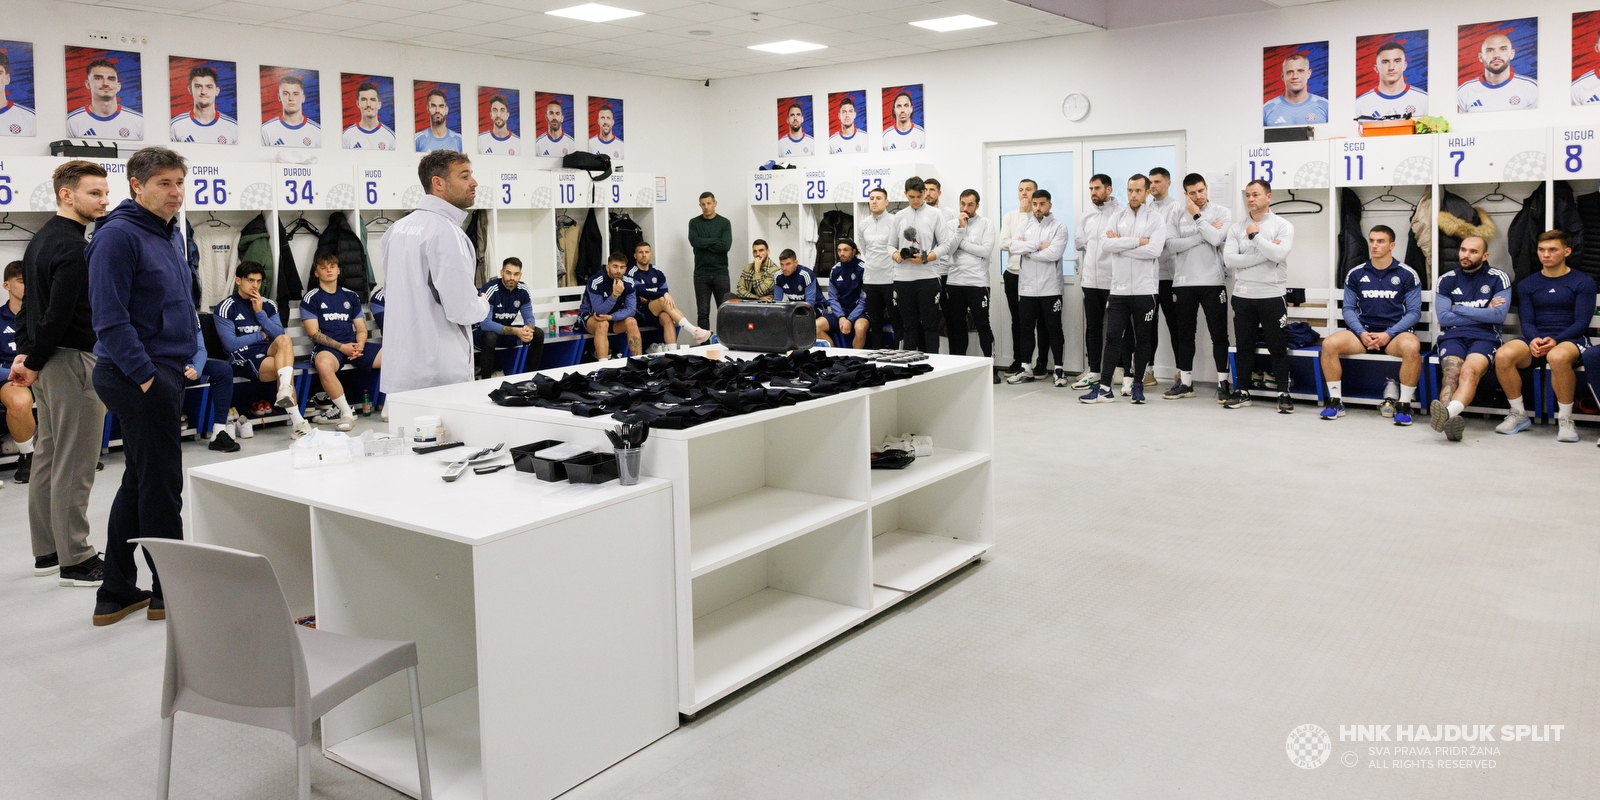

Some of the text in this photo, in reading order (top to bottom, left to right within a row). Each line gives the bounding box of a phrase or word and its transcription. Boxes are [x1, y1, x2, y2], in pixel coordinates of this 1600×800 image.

[1448, 137, 1476, 148] KALIK
[1563, 129, 1595, 142] SIGUR
[1248, 147, 1271, 158] LUČIĆ
[1343, 142, 1366, 152] ŠEGO
[1449, 150, 1465, 178] 7
[1564, 144, 1583, 173] 8
[192, 166, 219, 176] CAPAN
[283, 167, 312, 177] DURDOV
[364, 169, 382, 179] HUGO
[501, 173, 518, 181] EDGAR
[1249, 160, 1274, 184] 13
[1344, 155, 1364, 181] 11
[194, 179, 227, 205] 26
[285, 180, 314, 205] 34
[366, 181, 378, 205] 6
[502, 183, 512, 205] 3
[559, 183, 575, 204] 10
[612, 184, 620, 203] 9
[755, 183, 769, 201] 31
[807, 180, 826, 199] 29
[1361, 289, 1399, 299] TOMMY
[322, 312, 350, 321] TOMMY
